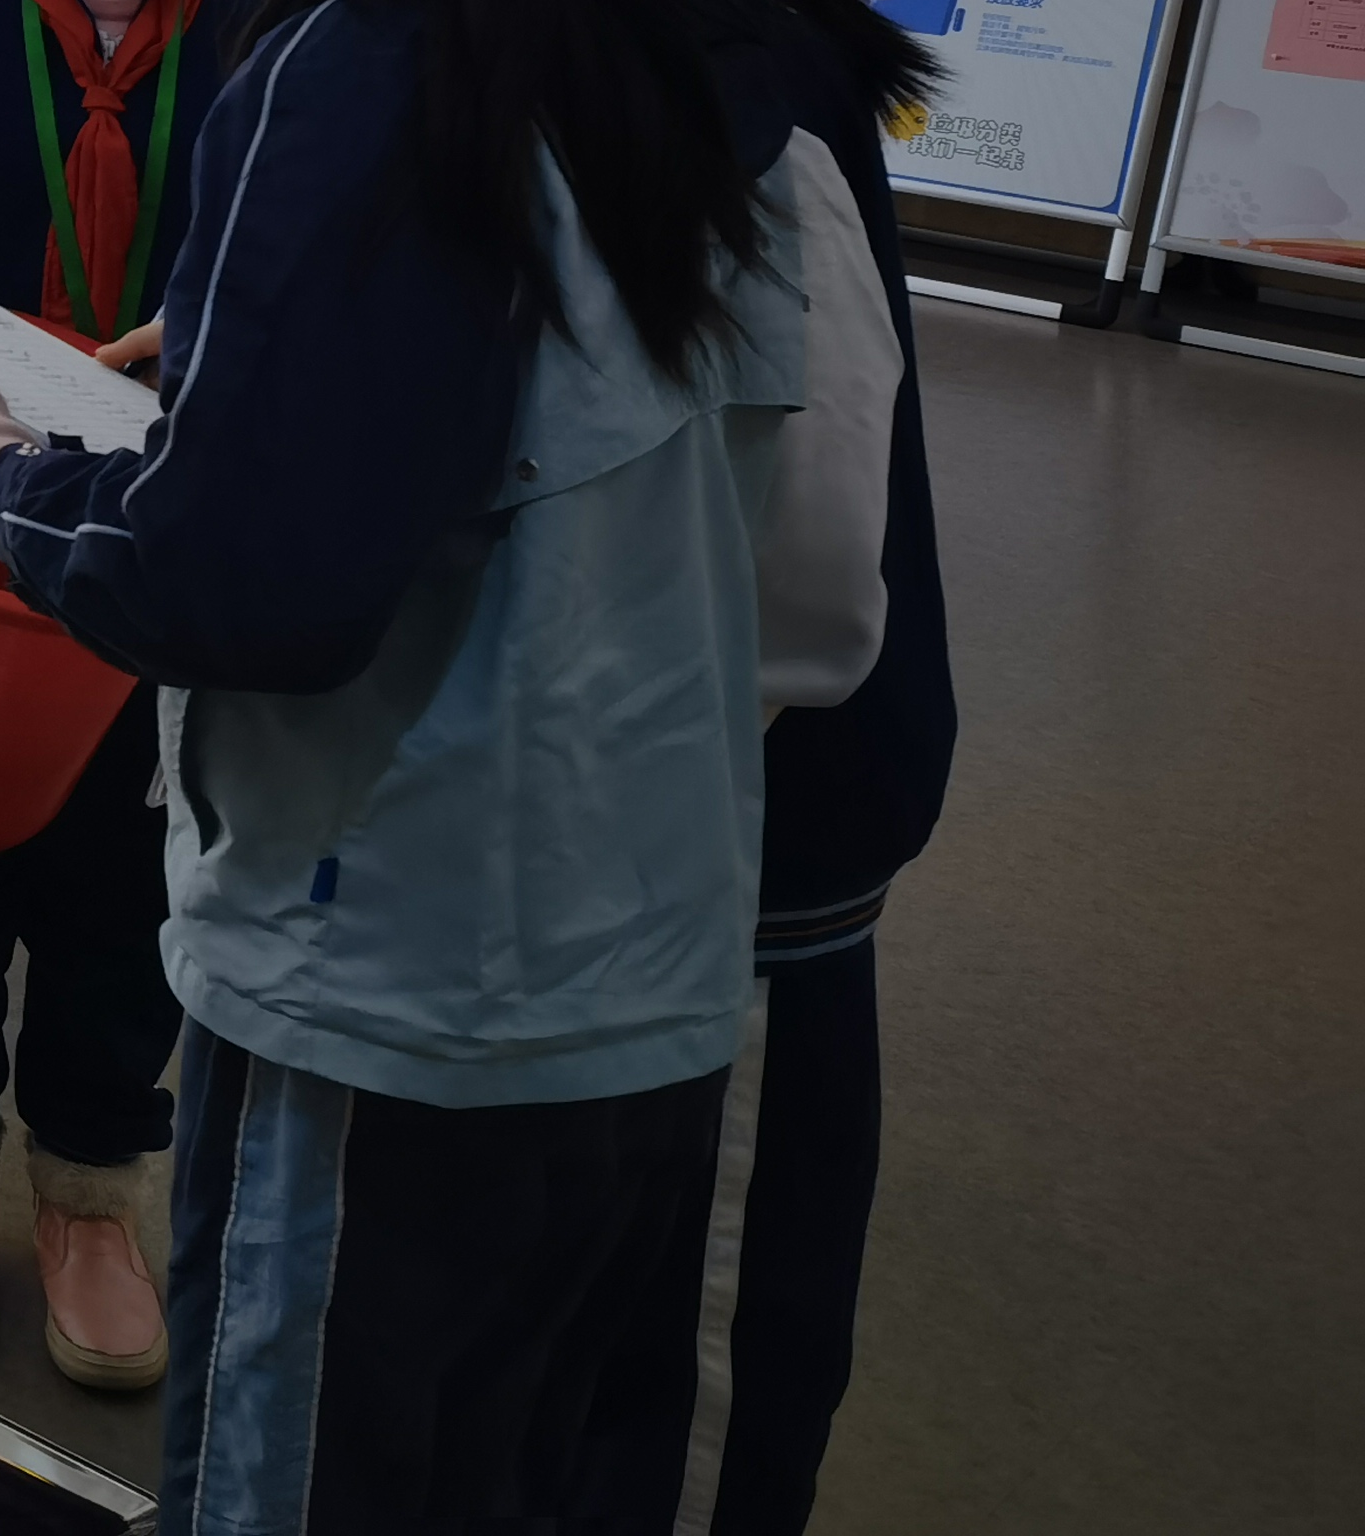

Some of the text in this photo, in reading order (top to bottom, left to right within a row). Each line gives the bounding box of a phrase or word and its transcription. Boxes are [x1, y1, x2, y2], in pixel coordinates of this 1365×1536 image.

[928, 113, 1023, 147] 垃圾分类
[907, 134, 1026, 171] 我们一起来
